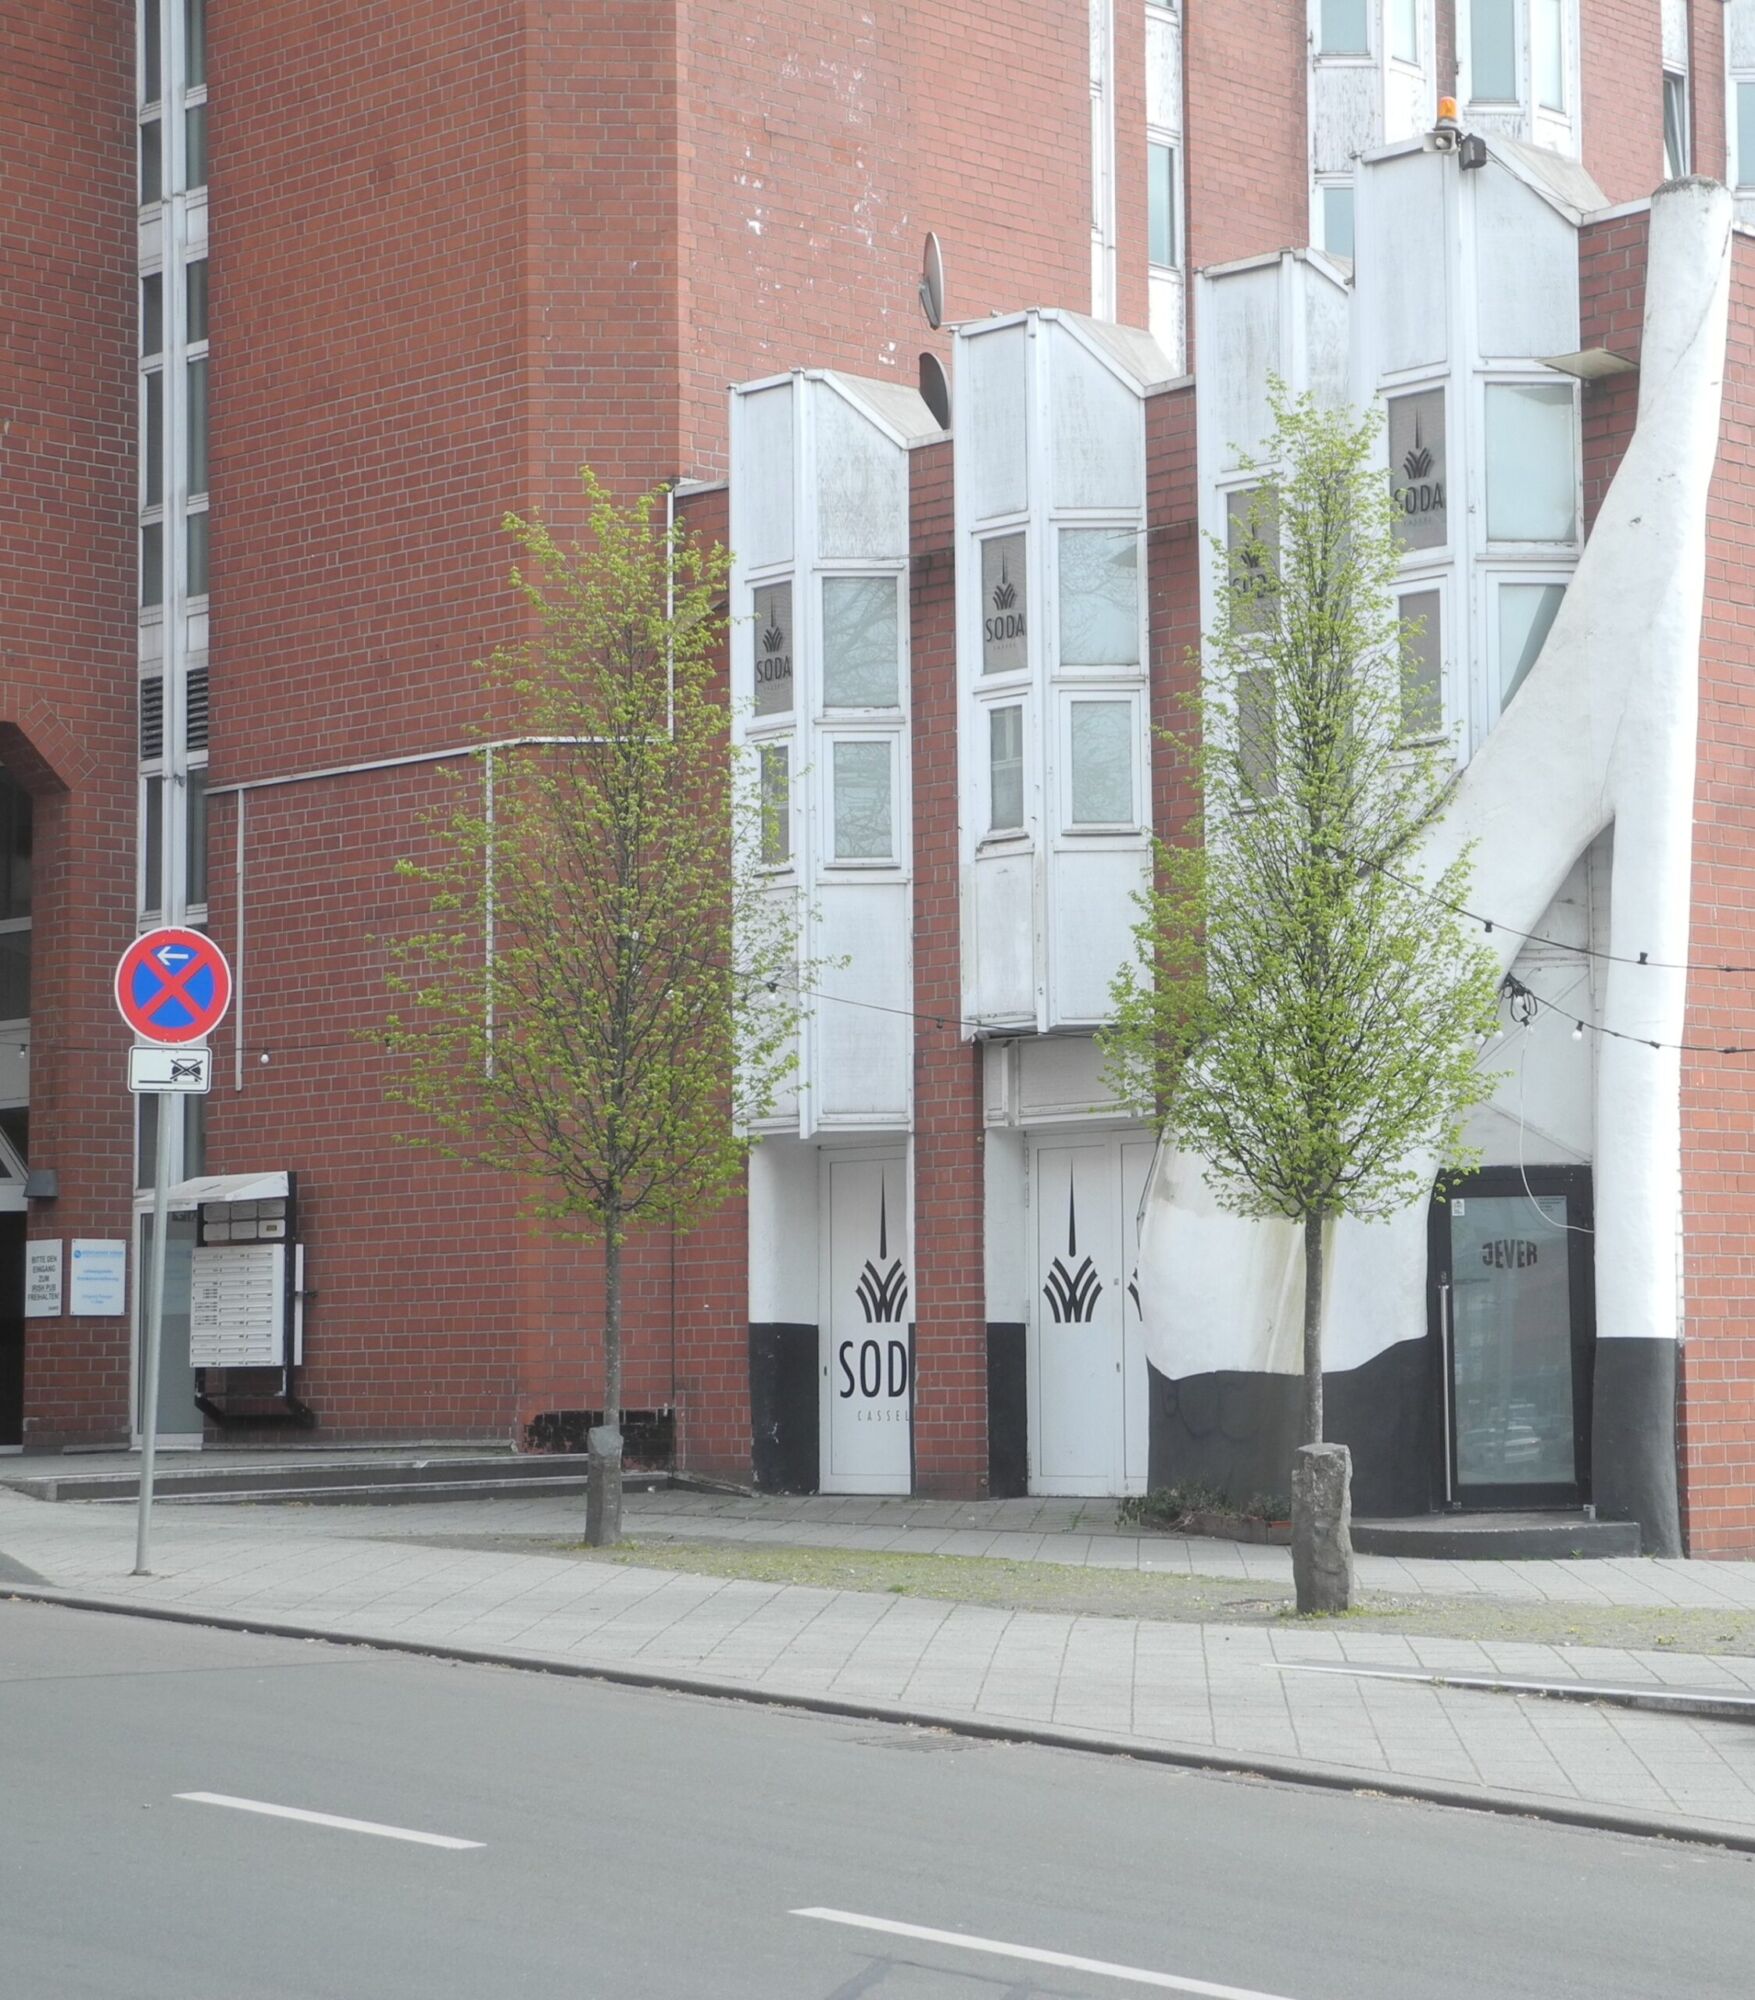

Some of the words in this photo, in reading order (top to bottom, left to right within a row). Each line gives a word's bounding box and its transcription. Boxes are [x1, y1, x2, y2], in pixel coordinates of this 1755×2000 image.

[985, 613, 1025, 642] SODA
[756, 655, 791, 684] SODA
[1481, 1239, 1538, 1269] JEVER
[32, 1265, 56, 1273] EINGANG
[857, 1409, 911, 1422] CASSEL
